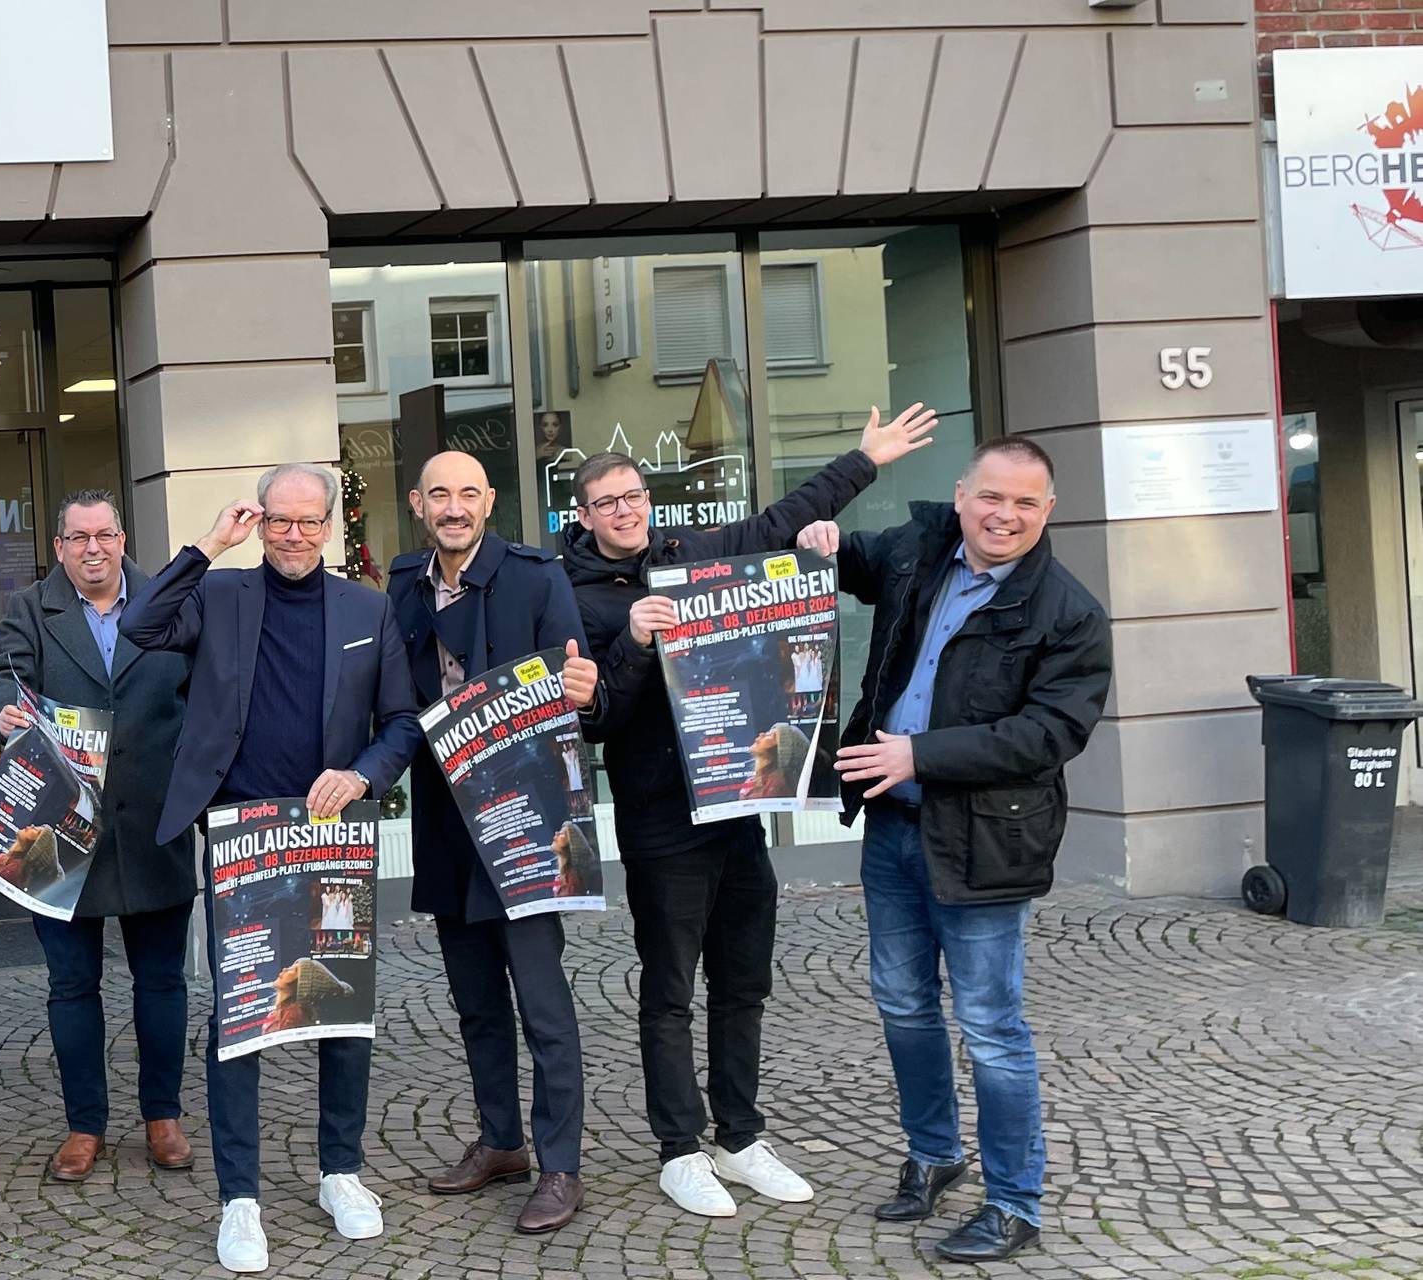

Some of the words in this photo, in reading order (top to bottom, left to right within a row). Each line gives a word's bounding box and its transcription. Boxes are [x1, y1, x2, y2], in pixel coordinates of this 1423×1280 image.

[1160, 347, 1213, 390] 55
[648, 504, 692, 528] EINE
[697, 500, 747, 525] STADT
[690, 562, 733, 585] porta
[769, 561, 792, 570] Radio
[775, 568, 790, 576] Erft
[672, 567, 835, 623] IKOLAUSSINGEN
[663, 620, 714, 642] SONNTAG
[746, 602, 806, 624] DEZEMBER
[809, 595, 835, 613] 2024
[449, 681, 488, 711] porta
[434, 672, 566, 762] NIKOLAUSSINGE
[445, 737, 486, 774] SONNTAG
[512, 701, 566, 729] DEZEMBER
[1347, 747, 1397, 758] Stadtwerke
[1350, 759, 1392, 771] Bergheim
[1354, 772, 1373, 787] 80
[1376, 772, 1385, 787] L
[241, 802, 278, 823] porta
[213, 822, 375, 868] NIKOLAUSSINGEN
[214, 859, 257, 883] SONNTAG
[285, 847, 342, 864] DEZEMBER
[346, 847, 374, 859] 2024
